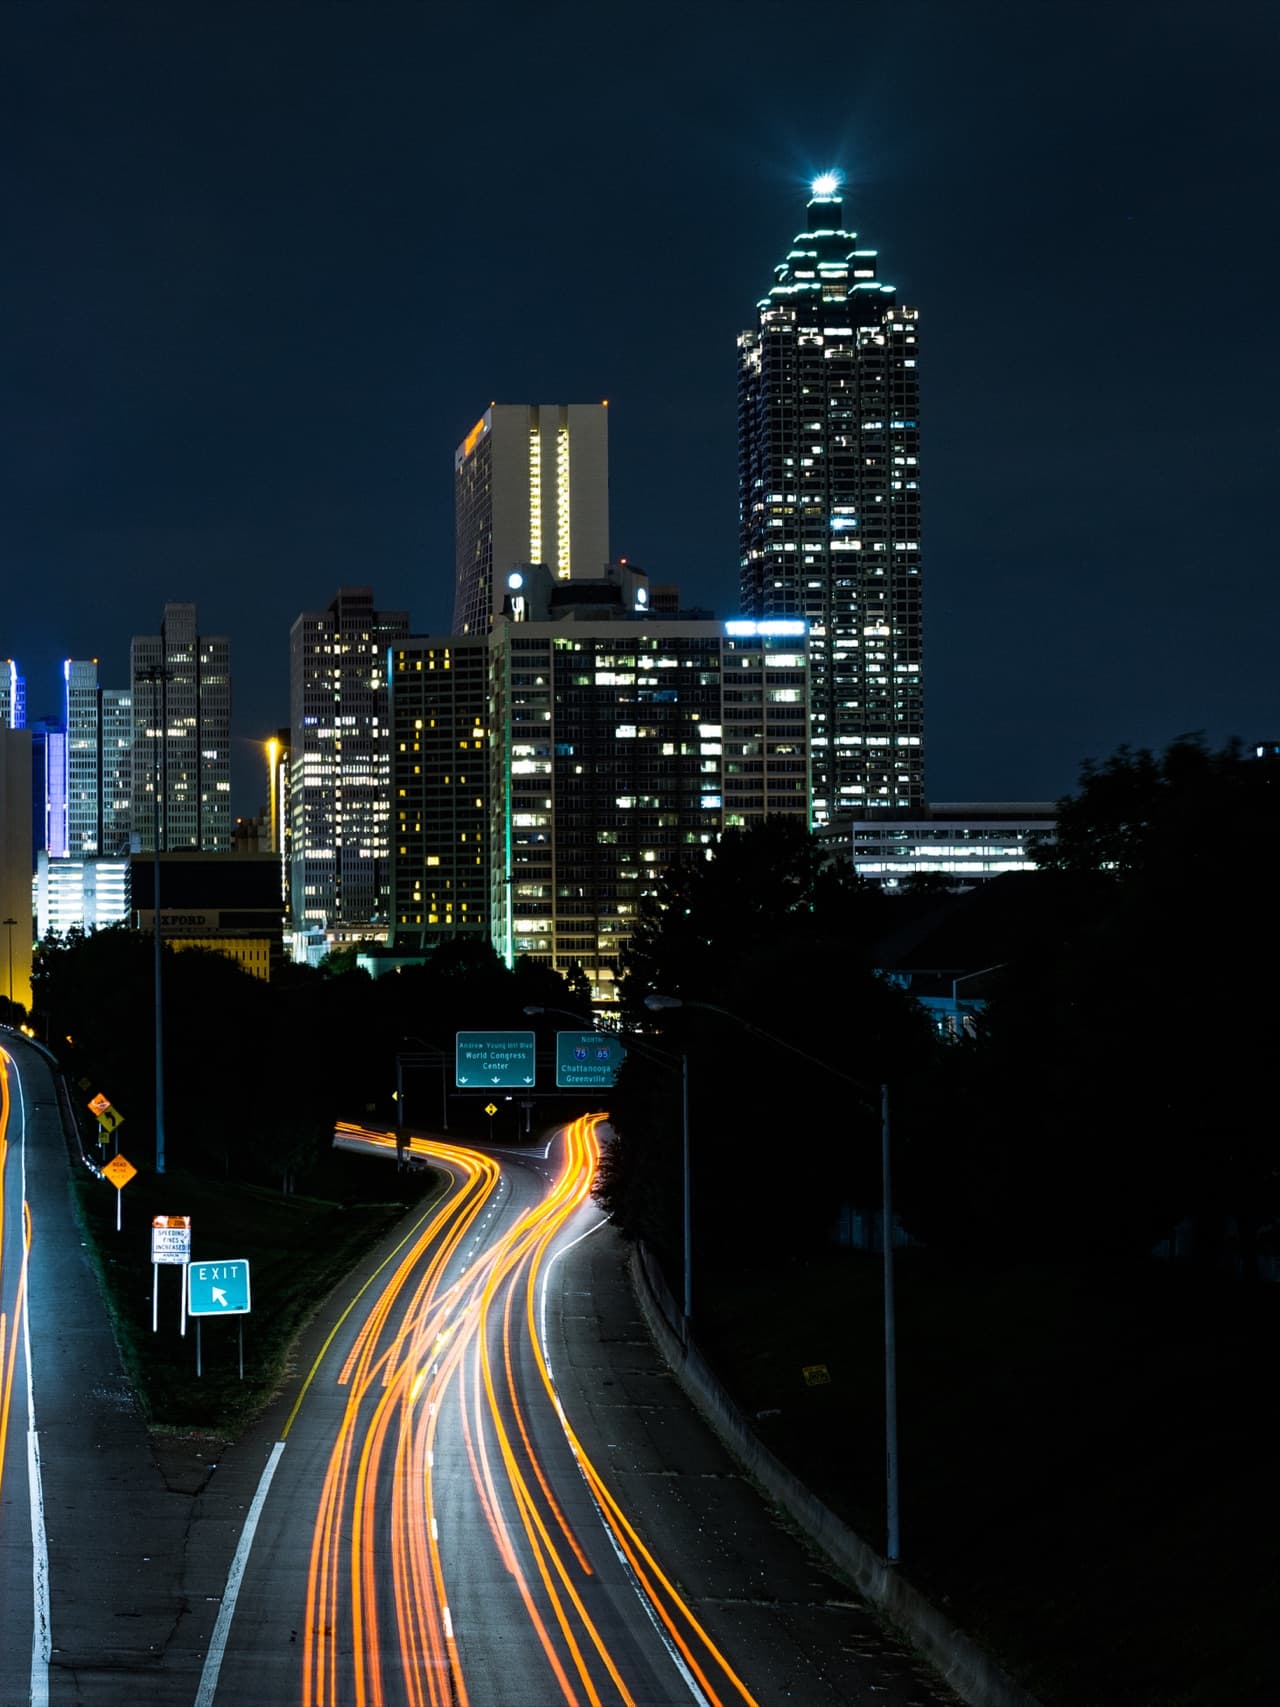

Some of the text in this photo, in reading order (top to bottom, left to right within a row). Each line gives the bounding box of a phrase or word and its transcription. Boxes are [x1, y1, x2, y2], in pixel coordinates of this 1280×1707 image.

[153, 915, 206, 925] XFORD
[490, 1052, 526, 1061] Congress
[483, 1062, 509, 1070] Center
[561, 1065, 611, 1074] Chattanooga
[199, 1266, 239, 1280] EXIT
